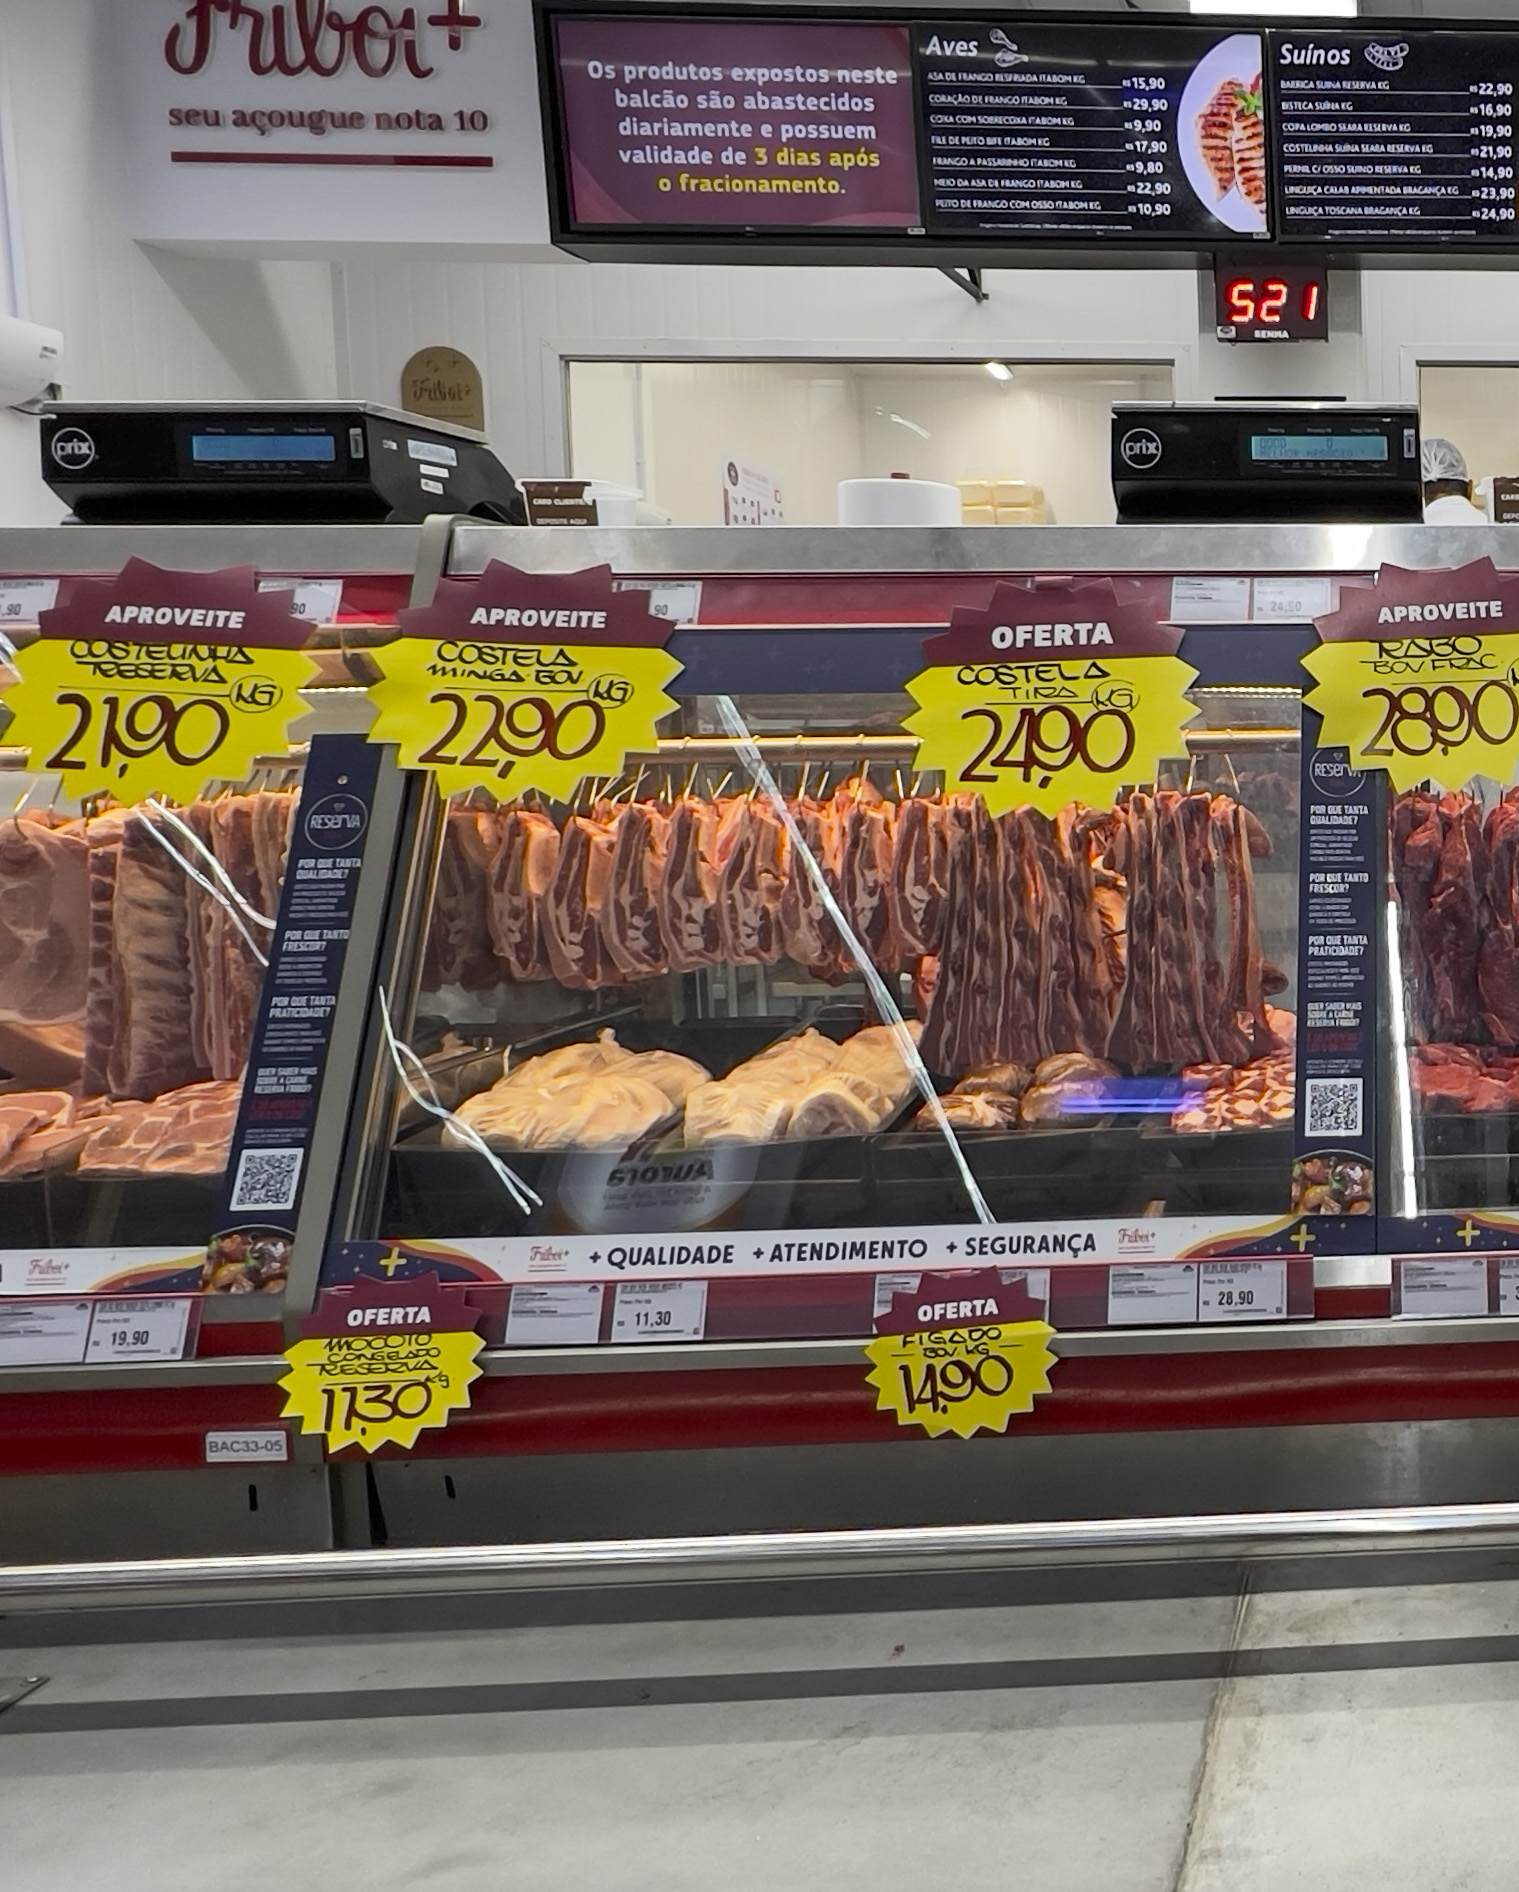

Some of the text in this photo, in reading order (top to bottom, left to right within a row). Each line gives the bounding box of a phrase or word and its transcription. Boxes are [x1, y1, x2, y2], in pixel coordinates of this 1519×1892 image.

[926, 36, 978, 57] Aves
[1280, 44, 1350, 65] Suínos
[588, 61, 897, 86] Os produtos expostos neste
[615, 89, 875, 112] balcão são abastecidos
[1479, 84, 1513, 96] 22,90
[168, 108, 489, 136] seu açougue nota 10
[619, 118, 876, 142] diariamente e possuem
[1134, 120, 1162, 132] 9,90
[619, 145, 880, 170] validade de 3 dias após
[1479, 146, 1512, 158] 21,90
[659, 174, 846, 194] o fracionamento.
[1480, 167, 1513, 180] 14,90
[1136, 182, 1171, 196] 22,90
[1137, 203, 1171, 217] 10,90
[1481, 209, 1515, 221] 24,90
[1225, 277, 1319, 322] 521
[56, 438, 90, 456] prix
[1125, 439, 1159, 457] prix
[105, 605, 246, 629] APROVEITE
[470, 607, 607, 628] APROVEITE
[1378, 601, 1503, 624] APROVEITE
[992, 622, 1114, 649] OFERTA
[437, 641, 579, 667] COSTELA
[957, 661, 1111, 685] COSTELA
[998, 686, 1079, 700] TIRA
[1360, 680, 1519, 756] 28,90
[45, 693, 230, 778] 21,90
[417, 693, 605, 779] 22,90
[959, 705, 1136, 789] 24,90
[607, 1233, 1096, 1270] QUALIDADE ATENDIMENTO SEGURANÇA
[1218, 1290, 1254, 1306] 28,90
[347, 1306, 431, 1326] OFERTA
[635, 1310, 672, 1327] 11,30
[918, 1298, 999, 1322] OFERTA
[111, 1330, 149, 1346] 19,90
[902, 1327, 1002, 1348] FIGADO
[208, 1440, 283, 1454] BAC33-05
